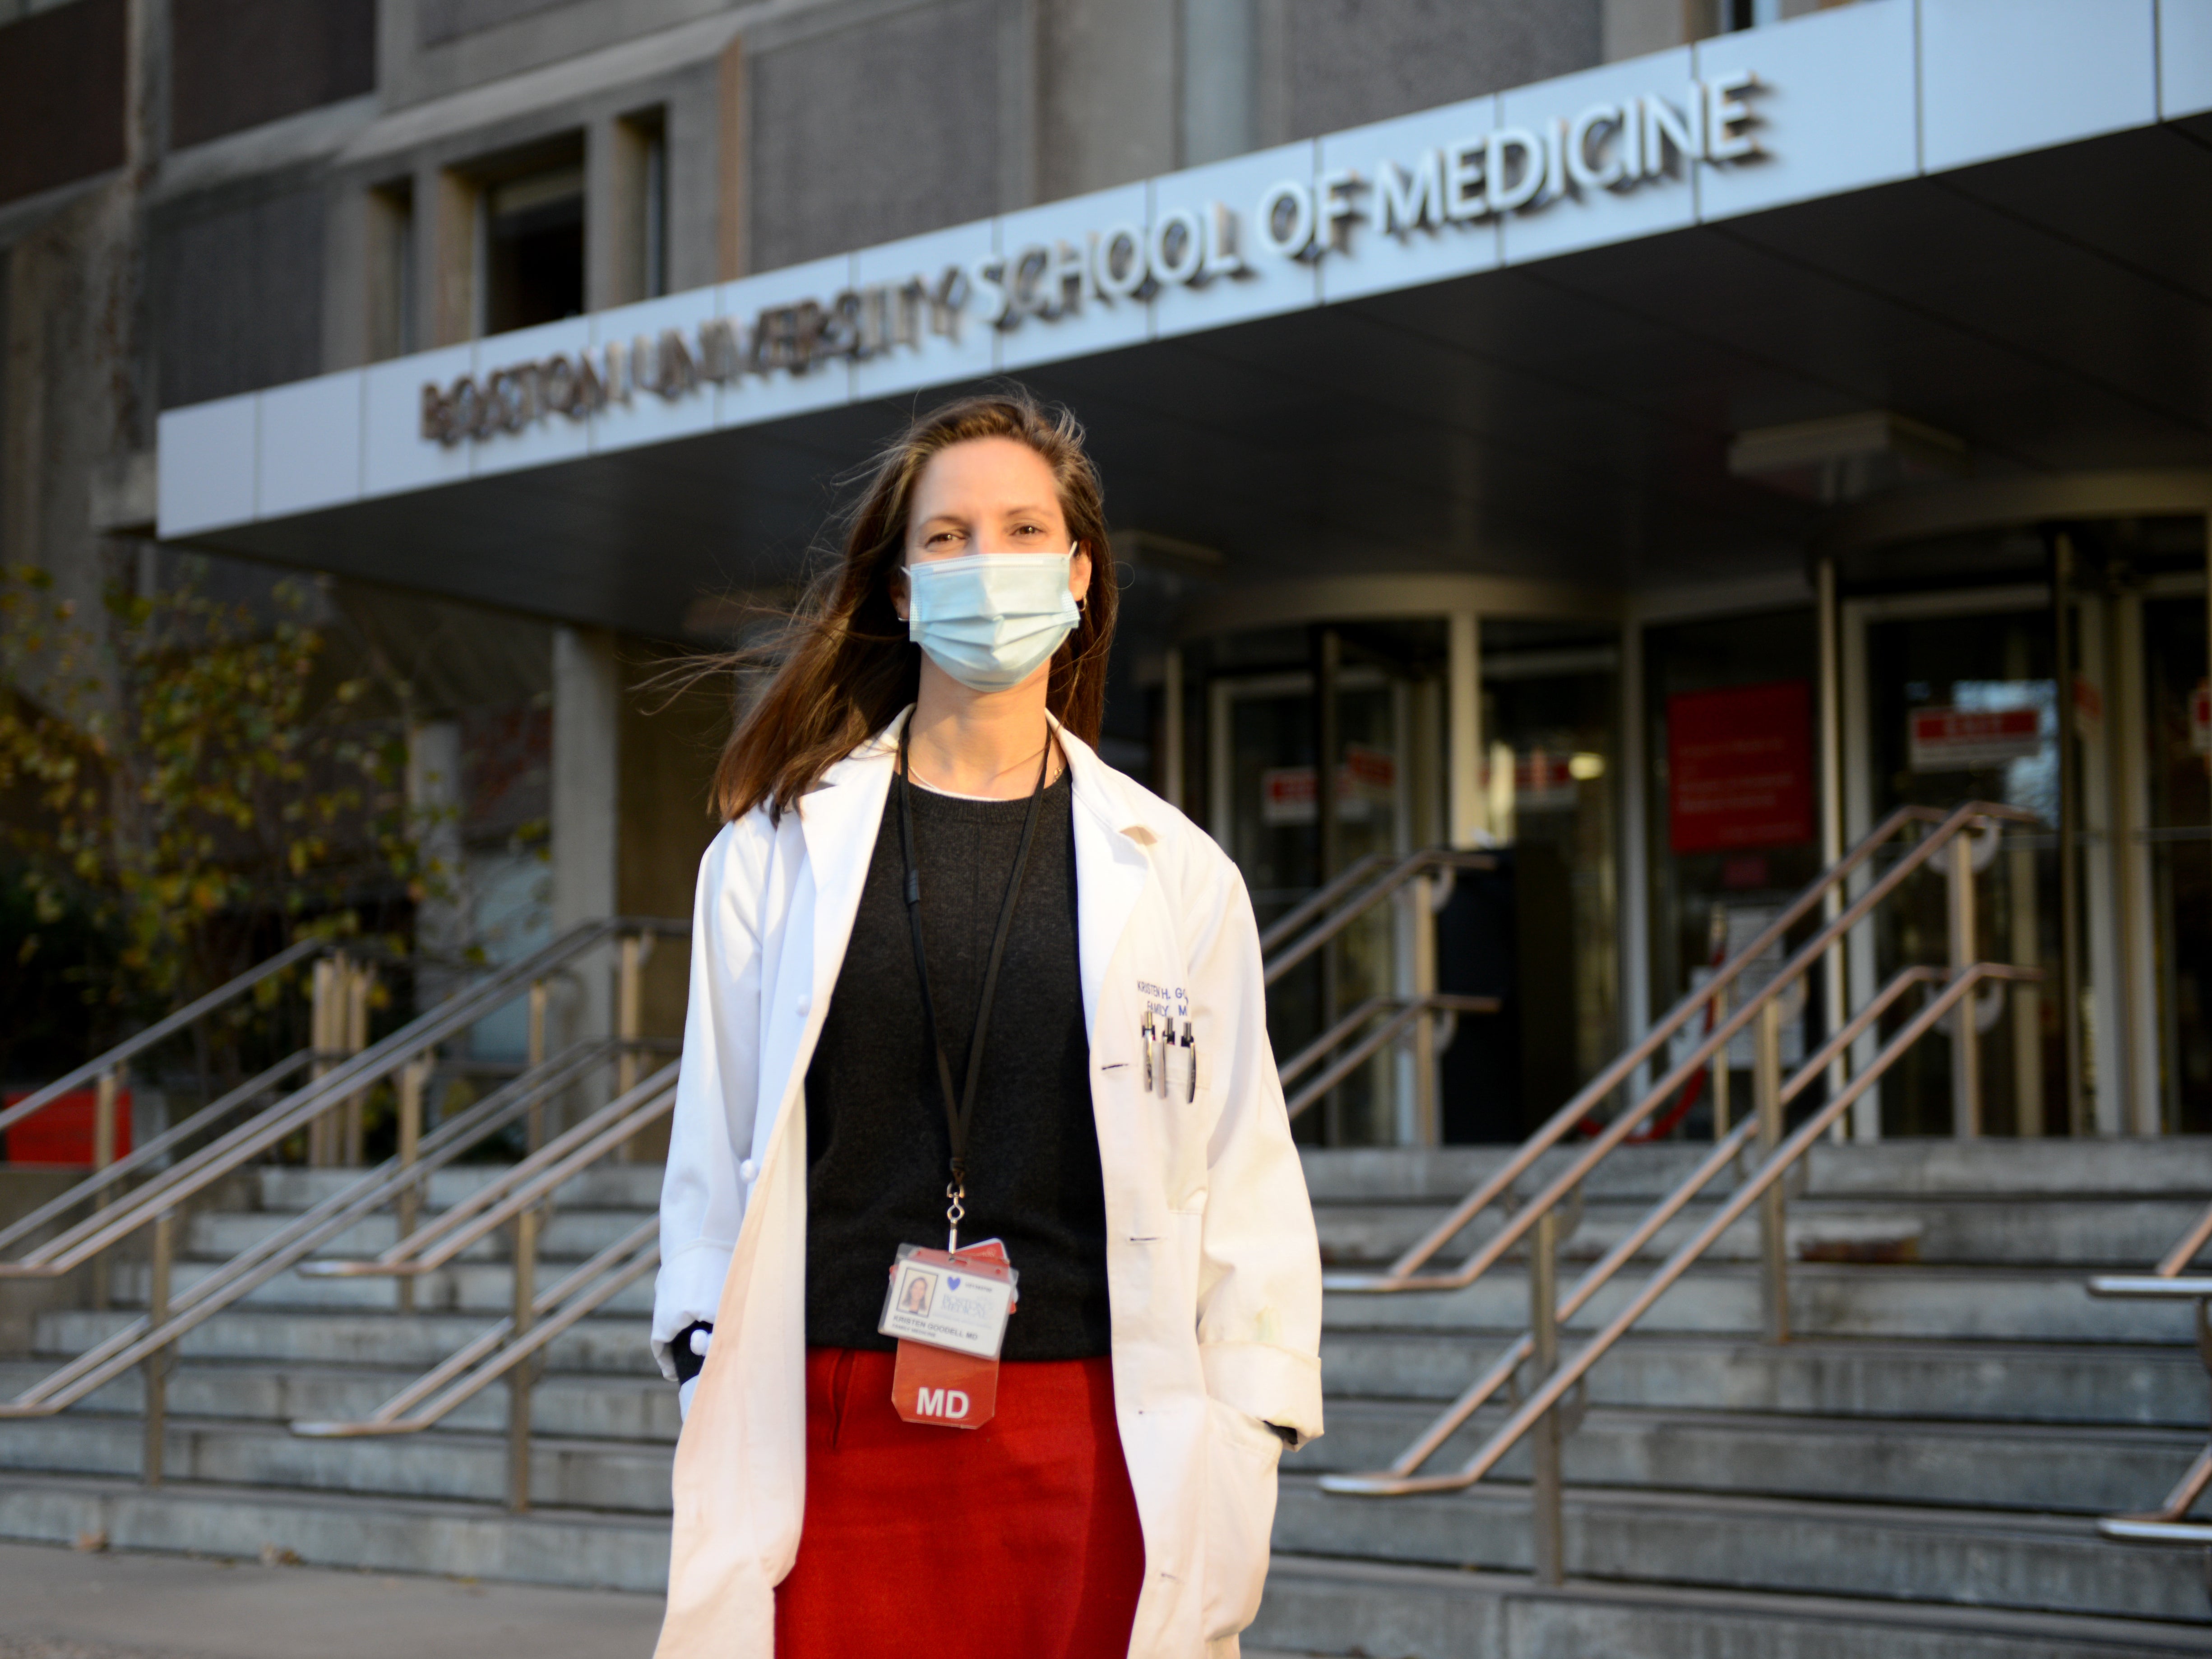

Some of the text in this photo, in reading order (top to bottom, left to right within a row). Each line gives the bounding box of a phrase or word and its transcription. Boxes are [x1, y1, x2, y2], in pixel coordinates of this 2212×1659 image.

[968, 199, 1249, 329] SCHOOL
[1256, 168, 1361, 262] OF
[1372, 68, 1767, 239] MEDICINE
[1137, 980, 1160, 997] KRISTEN
[1161, 988, 1171, 1000] H.
[1147, 1000, 1169, 1017] FAMILY
[893, 1315, 926, 1328] KRISTEN
[927, 1323, 964, 1338] GOODELL
[966, 1332, 978, 1341] MD
[916, 1387, 969, 1419] MD
